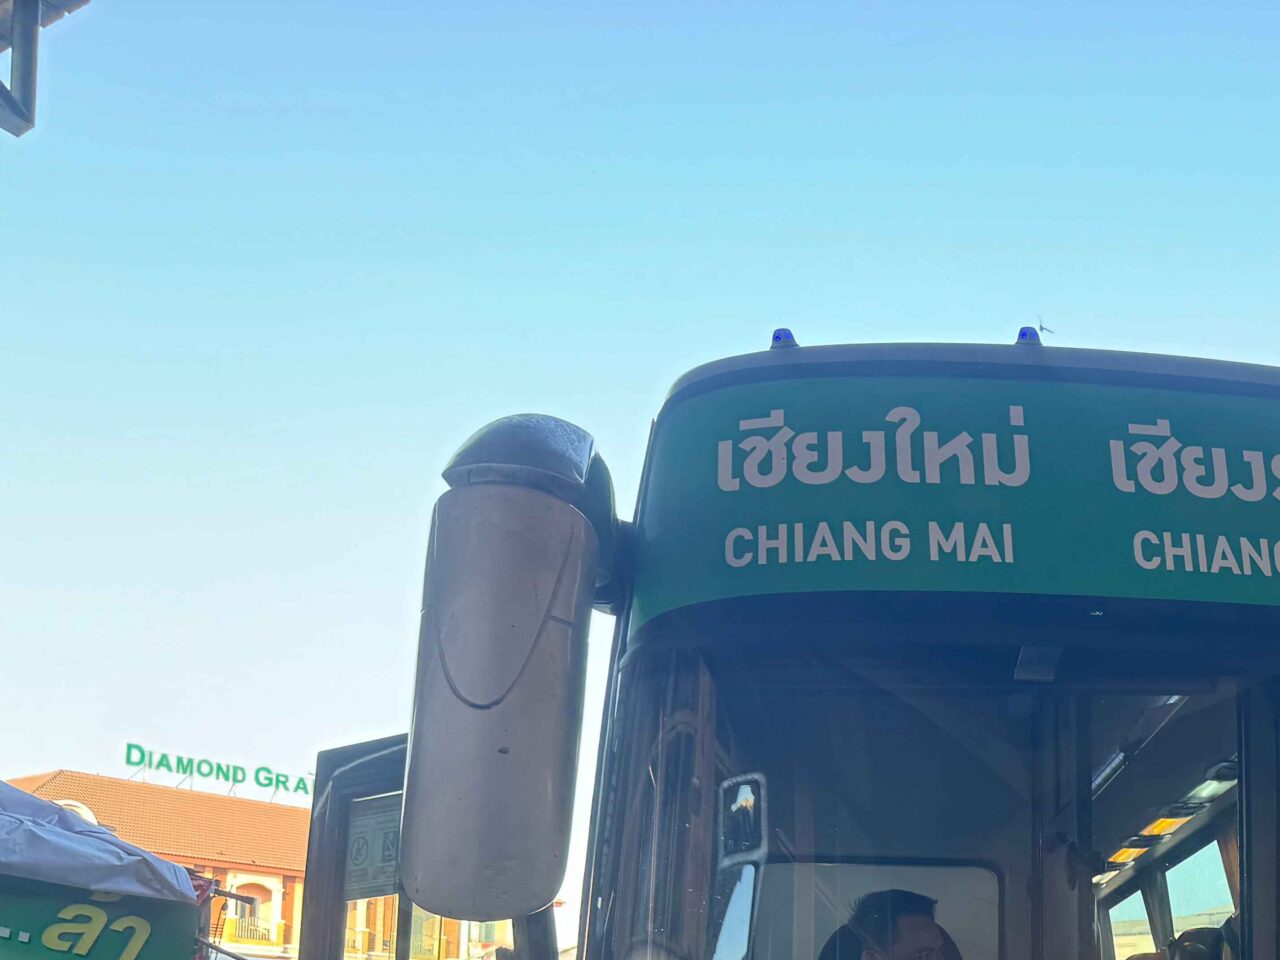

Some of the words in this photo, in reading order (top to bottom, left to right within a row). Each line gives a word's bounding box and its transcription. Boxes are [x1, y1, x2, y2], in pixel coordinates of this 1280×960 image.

[716, 405, 1031, 491] เชียงใหม่
[724, 520, 911, 569] CHIANG
[929, 522, 1014, 564] MAI
[125, 742, 246, 784] DIAMOND
[254, 765, 314, 795] GRA
